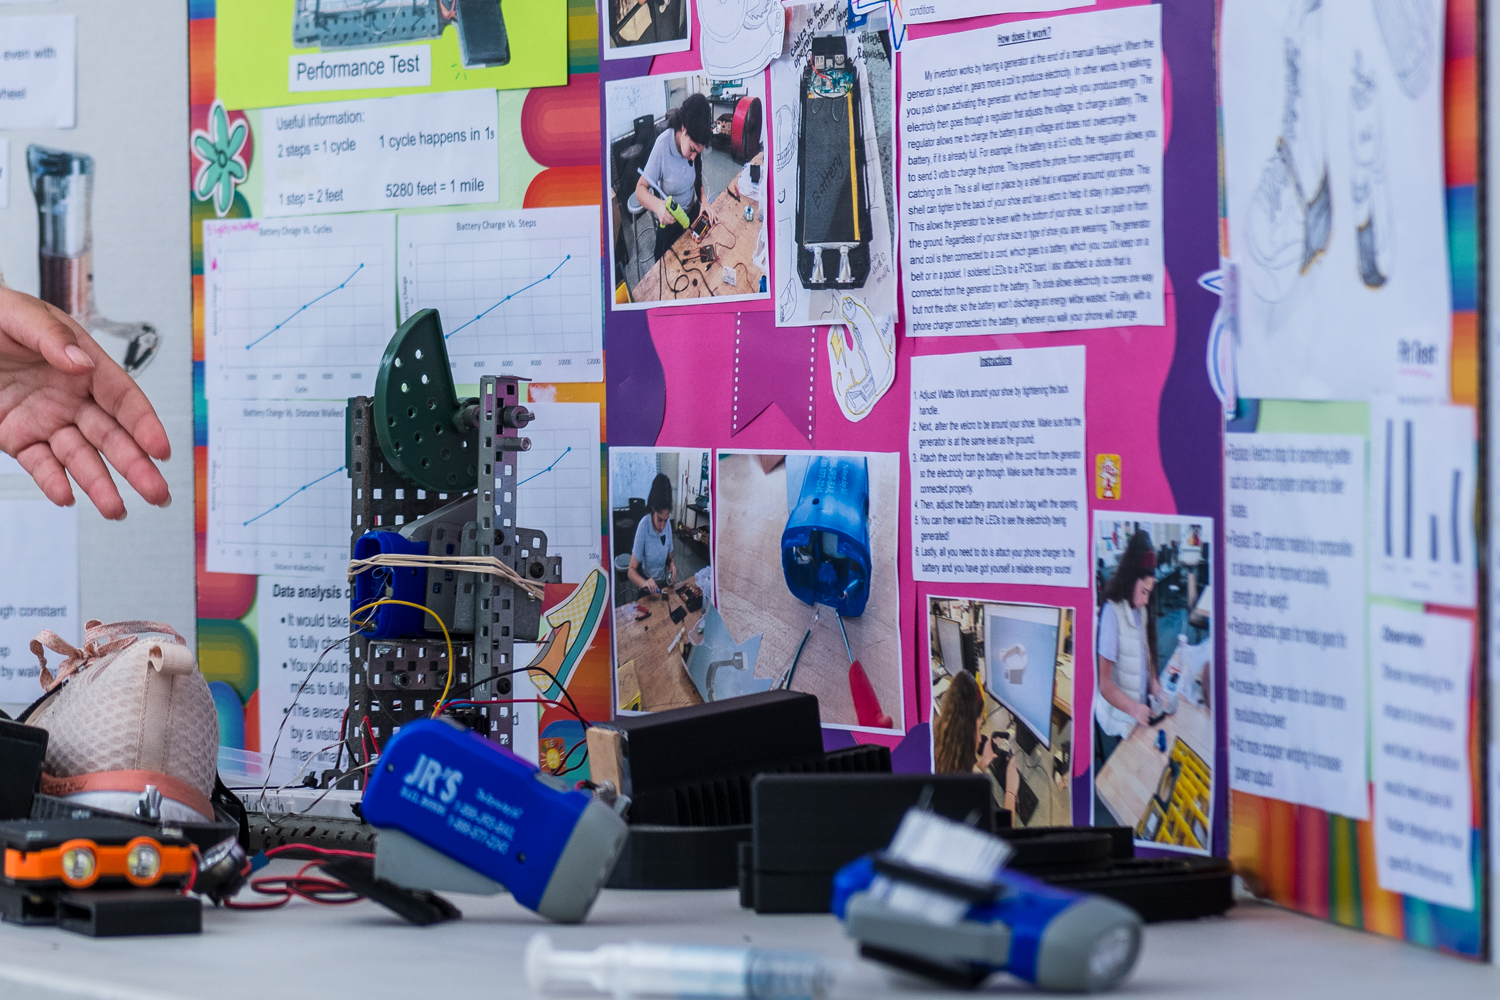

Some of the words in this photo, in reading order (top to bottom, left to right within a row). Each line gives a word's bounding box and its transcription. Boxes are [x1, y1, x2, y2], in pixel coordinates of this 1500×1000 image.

[297, 57, 385, 81] Performance
[390, 54, 420, 74] Test
[276, 114, 306, 131] Useful
[308, 111, 365, 128] information:
[906, 107, 921, 118] you
[380, 135, 385, 149] 1
[389, 132, 416, 150] cycle
[419, 129, 467, 148] happens
[470, 127, 481, 141] in
[485, 126, 495, 141] 1s
[278, 144, 284, 158] 2
[286, 143, 311, 160] steps
[323, 141, 328, 154] 1
[331, 138, 356, 156] cycle
[385, 183, 414, 199] 5280
[416, 181, 437, 196] feet
[450, 180, 455, 193] 1
[459, 178, 485, 193] mile
[279, 193, 284, 206] 1
[287, 193, 306, 208] step
[317, 190, 323, 203] 2
[325, 189, 344, 203] feet
[456, 221, 480, 232] Battery
[481, 220, 505, 232] Charge
[518, 218, 537, 230] Steps
[908, 221, 925, 231] This
[910, 255, 924, 264] and
[273, 583, 296, 598] Data
[298, 584, 342, 602] analysis
[19, 605, 67, 618] constant
[296, 613, 325, 628] would
[327, 613, 350, 628] take
[288, 635, 298, 649] to
[300, 634, 320, 653] fully
[289, 658, 307, 673] You
[317, 682, 327, 695] to
[329, 681, 349, 699] fully
[292, 702, 310, 717] The
[291, 725, 304, 743] by
[306, 729, 313, 740] a
[315, 726, 341, 741] visito
